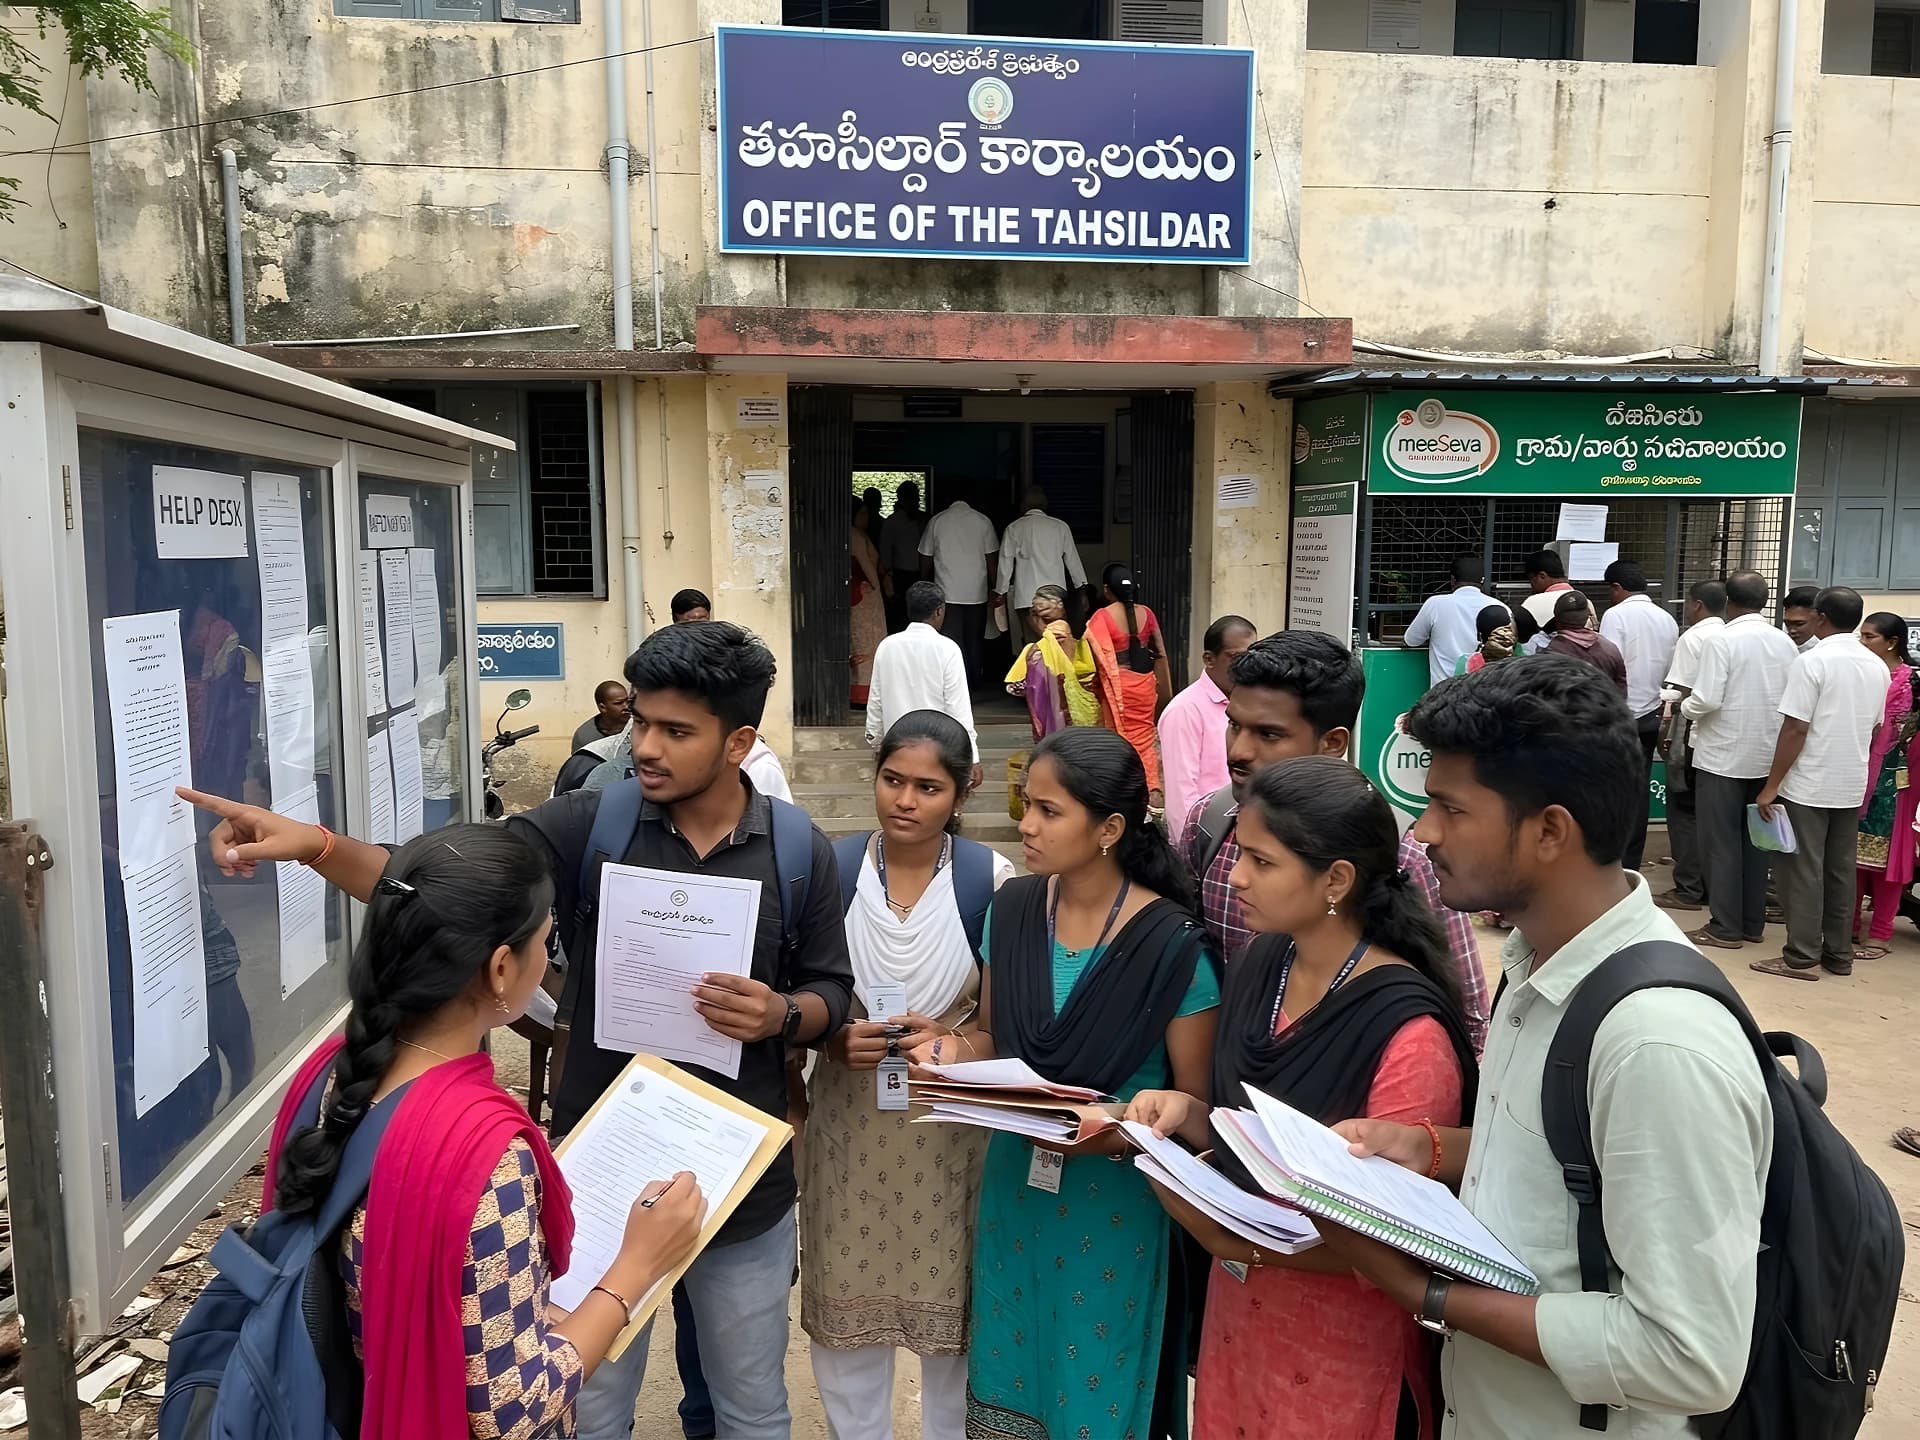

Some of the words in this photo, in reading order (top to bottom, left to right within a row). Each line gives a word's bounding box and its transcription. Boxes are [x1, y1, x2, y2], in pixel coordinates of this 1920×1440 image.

[738, 110, 967, 193] తహసీల్దార్
[978, 135, 1236, 199] కార్యాలయం
[742, 199, 877, 240] OFFICE
[888, 203, 936, 241] OF
[947, 206, 1020, 243] THE
[1031, 208, 1231, 249] TAHSILDAR
[1398, 434, 1482, 453] meeSeva
[159, 494, 204, 525] HELP
[207, 498, 243, 528] DESK
